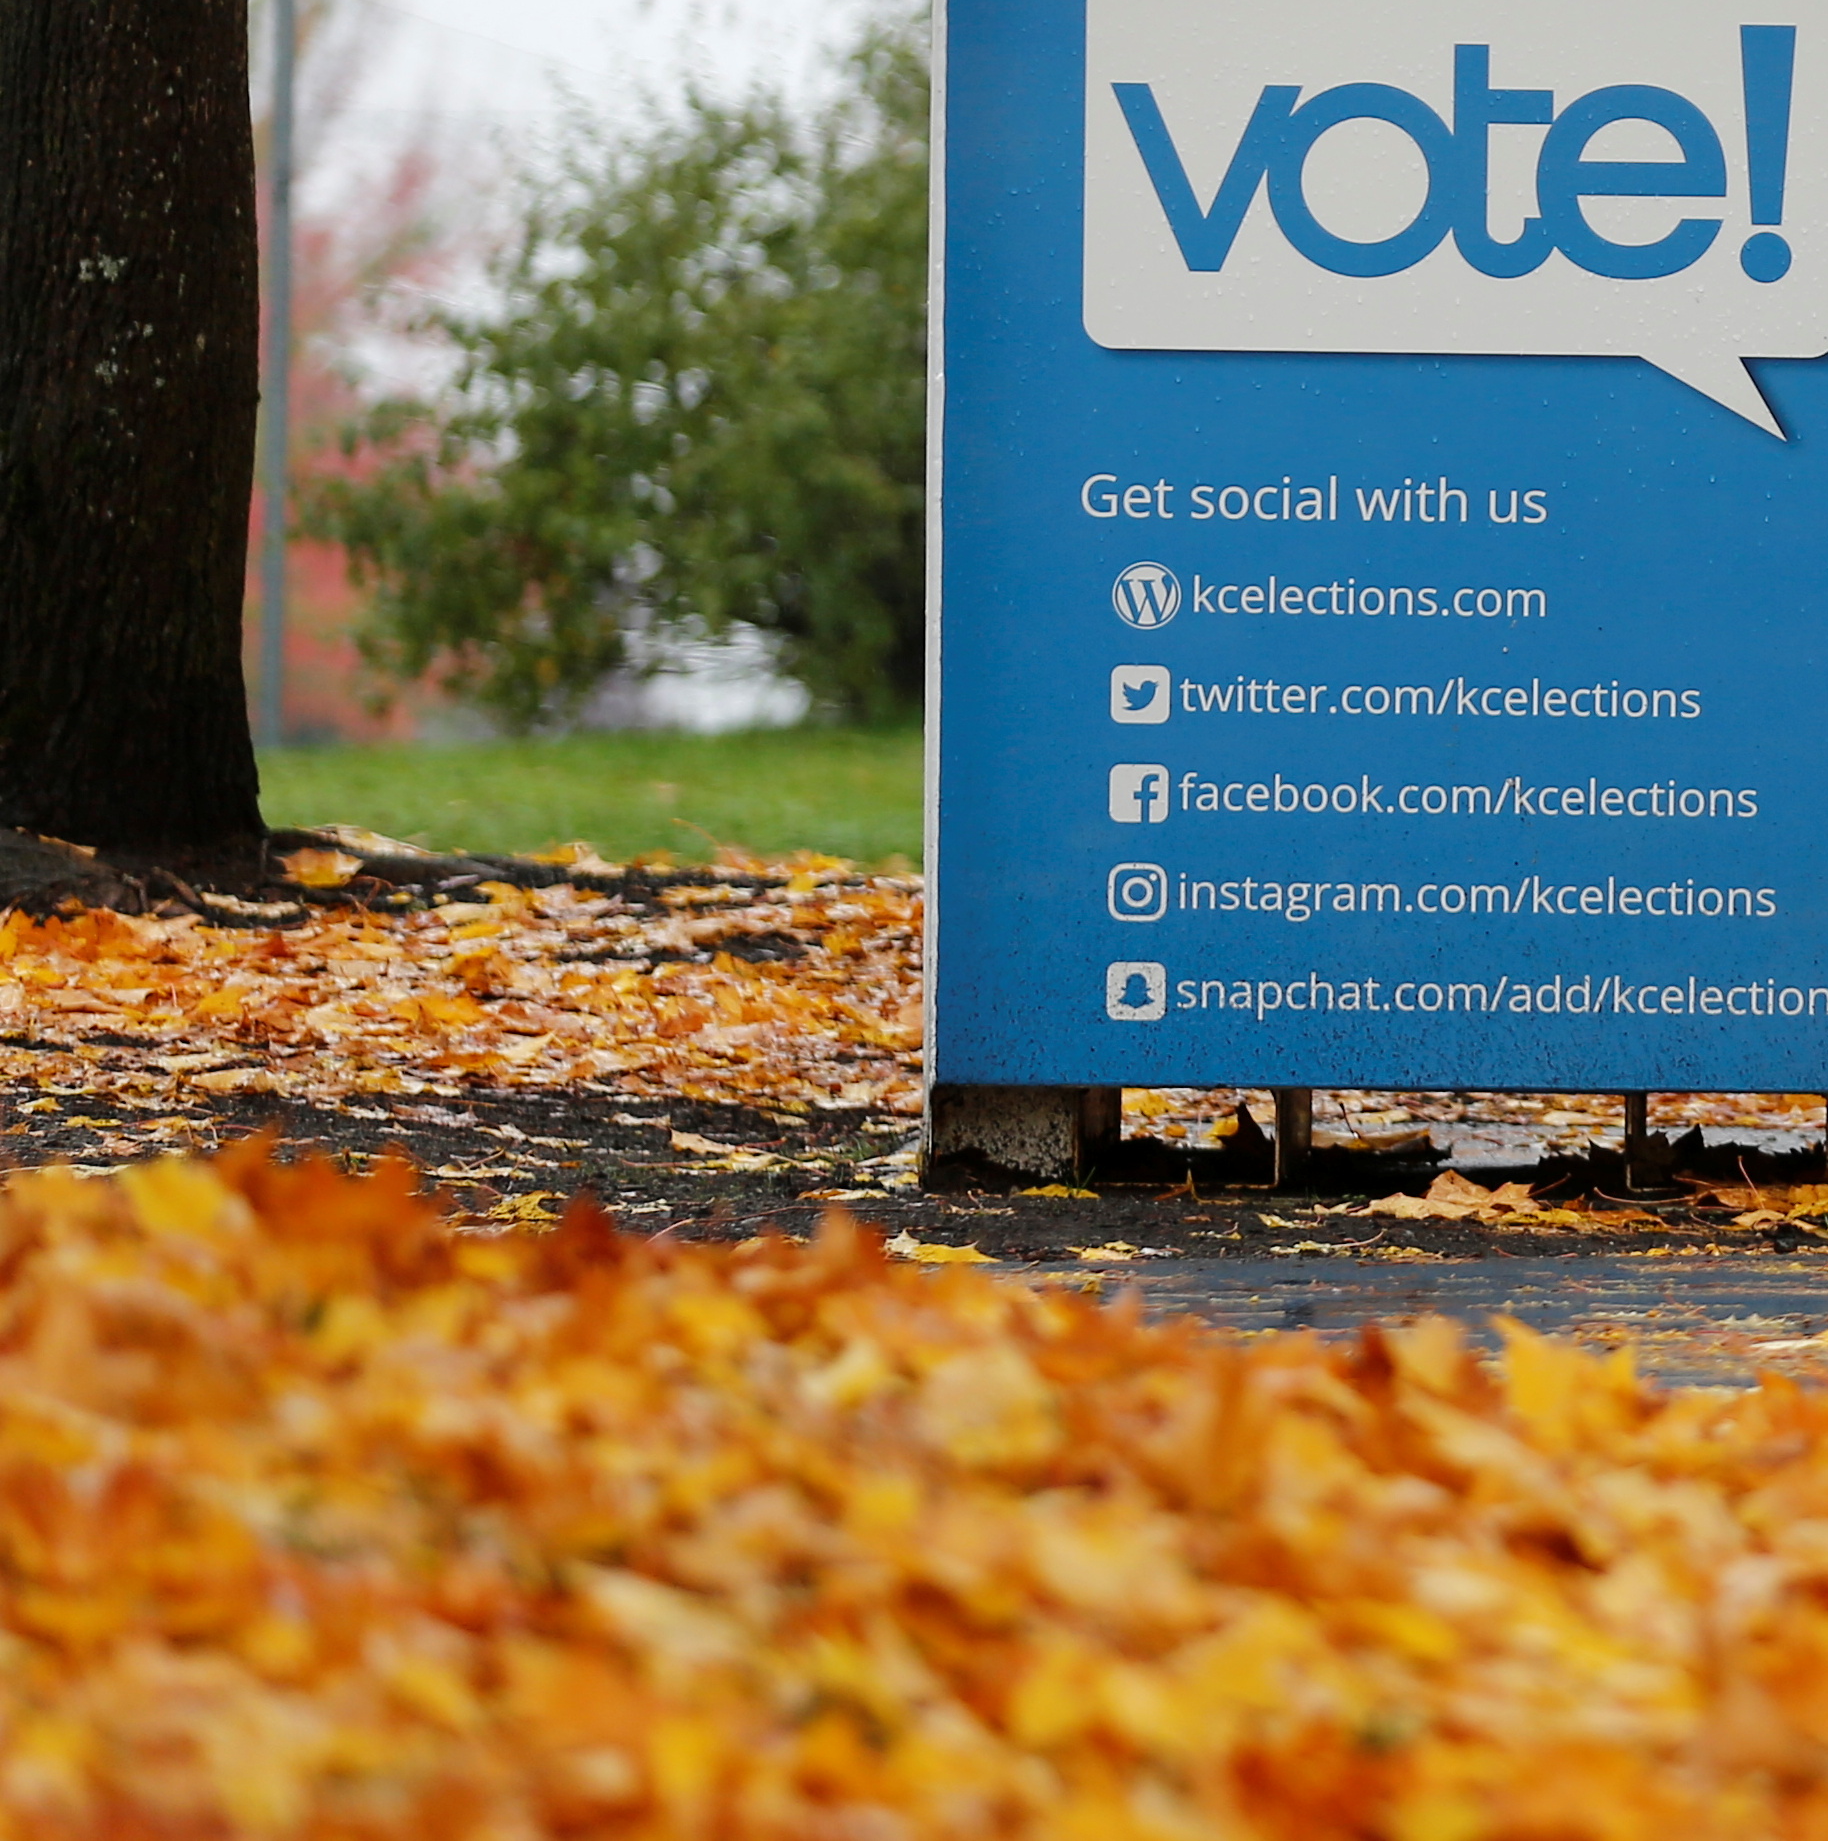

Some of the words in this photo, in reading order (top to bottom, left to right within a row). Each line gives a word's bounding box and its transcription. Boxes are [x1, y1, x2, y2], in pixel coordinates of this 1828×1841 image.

[1112, 25, 1797, 284] vote!
[1081, 473, 1174, 519] Get
[1190, 475, 1337, 521] social
[1355, 476, 1468, 523] with
[1489, 489, 1548, 524] us
[1193, 574, 1547, 618] kcelections.com
[1179, 675, 1702, 719] twitter.com/kcelections
[1178, 771, 1759, 818] facebook.com/kcelections
[1178, 872, 1778, 922] instagram.com/kcelections
